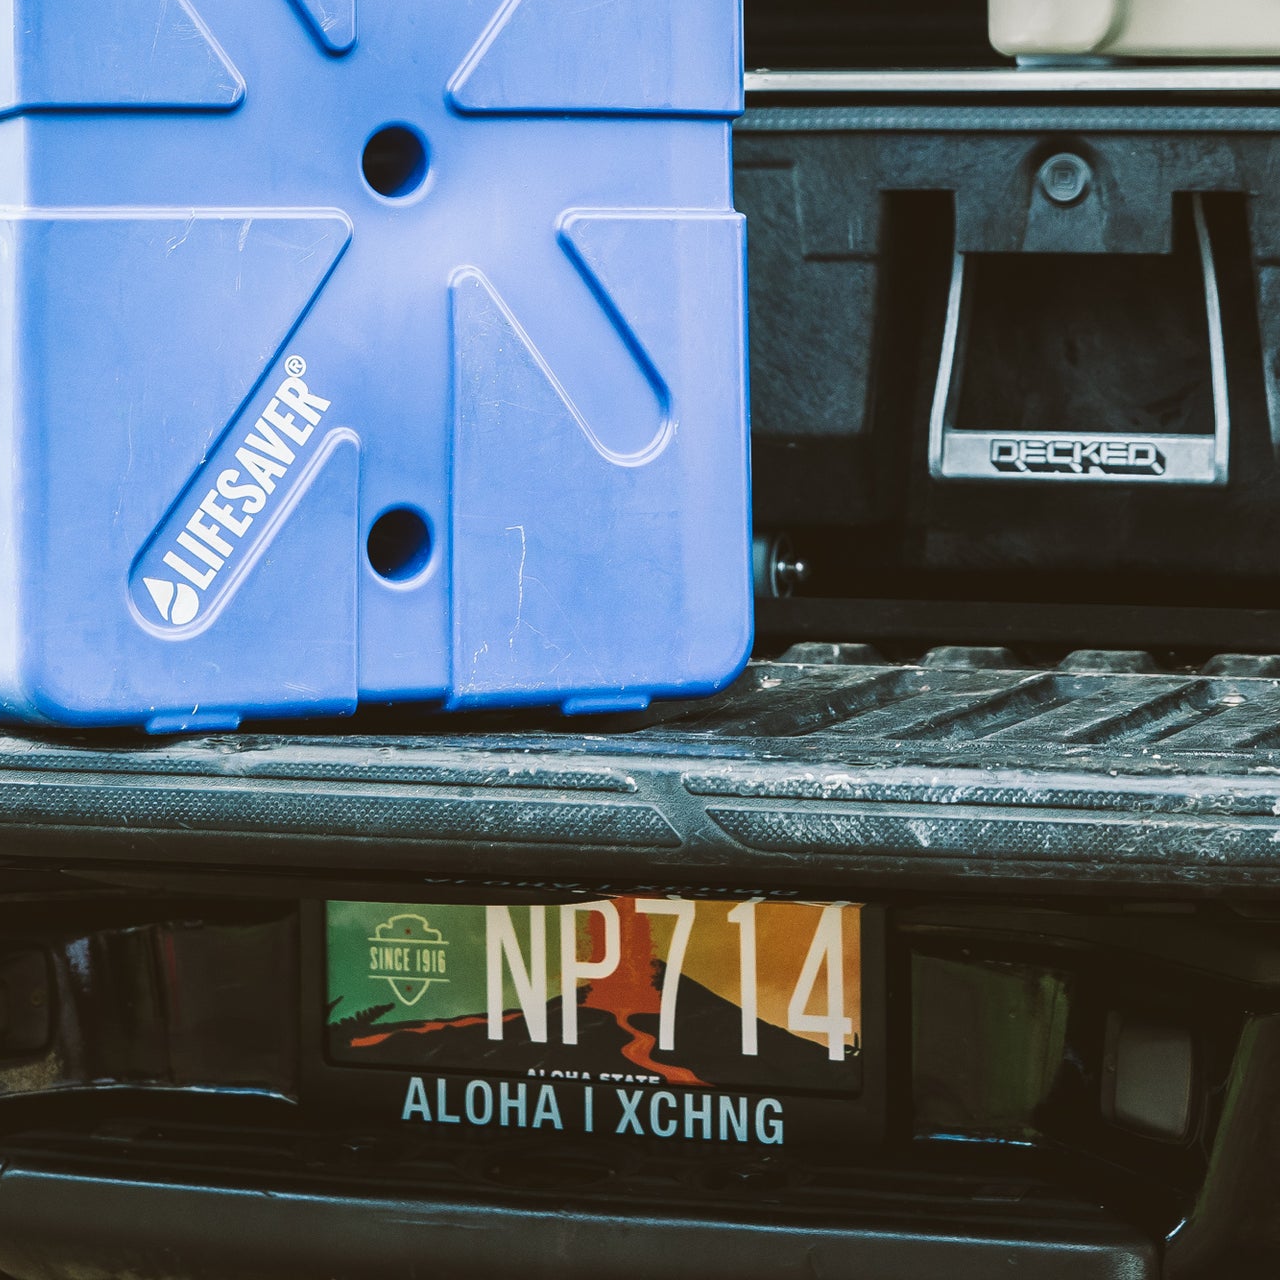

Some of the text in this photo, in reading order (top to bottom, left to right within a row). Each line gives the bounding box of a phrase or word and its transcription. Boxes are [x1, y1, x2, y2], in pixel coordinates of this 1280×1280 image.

[991, 439, 1166, 475] DECKED
[369, 946, 446, 973] SINCE 1916
[402, 1076, 564, 1130] ALOHA
[616, 1088, 784, 1145] XCHNG
